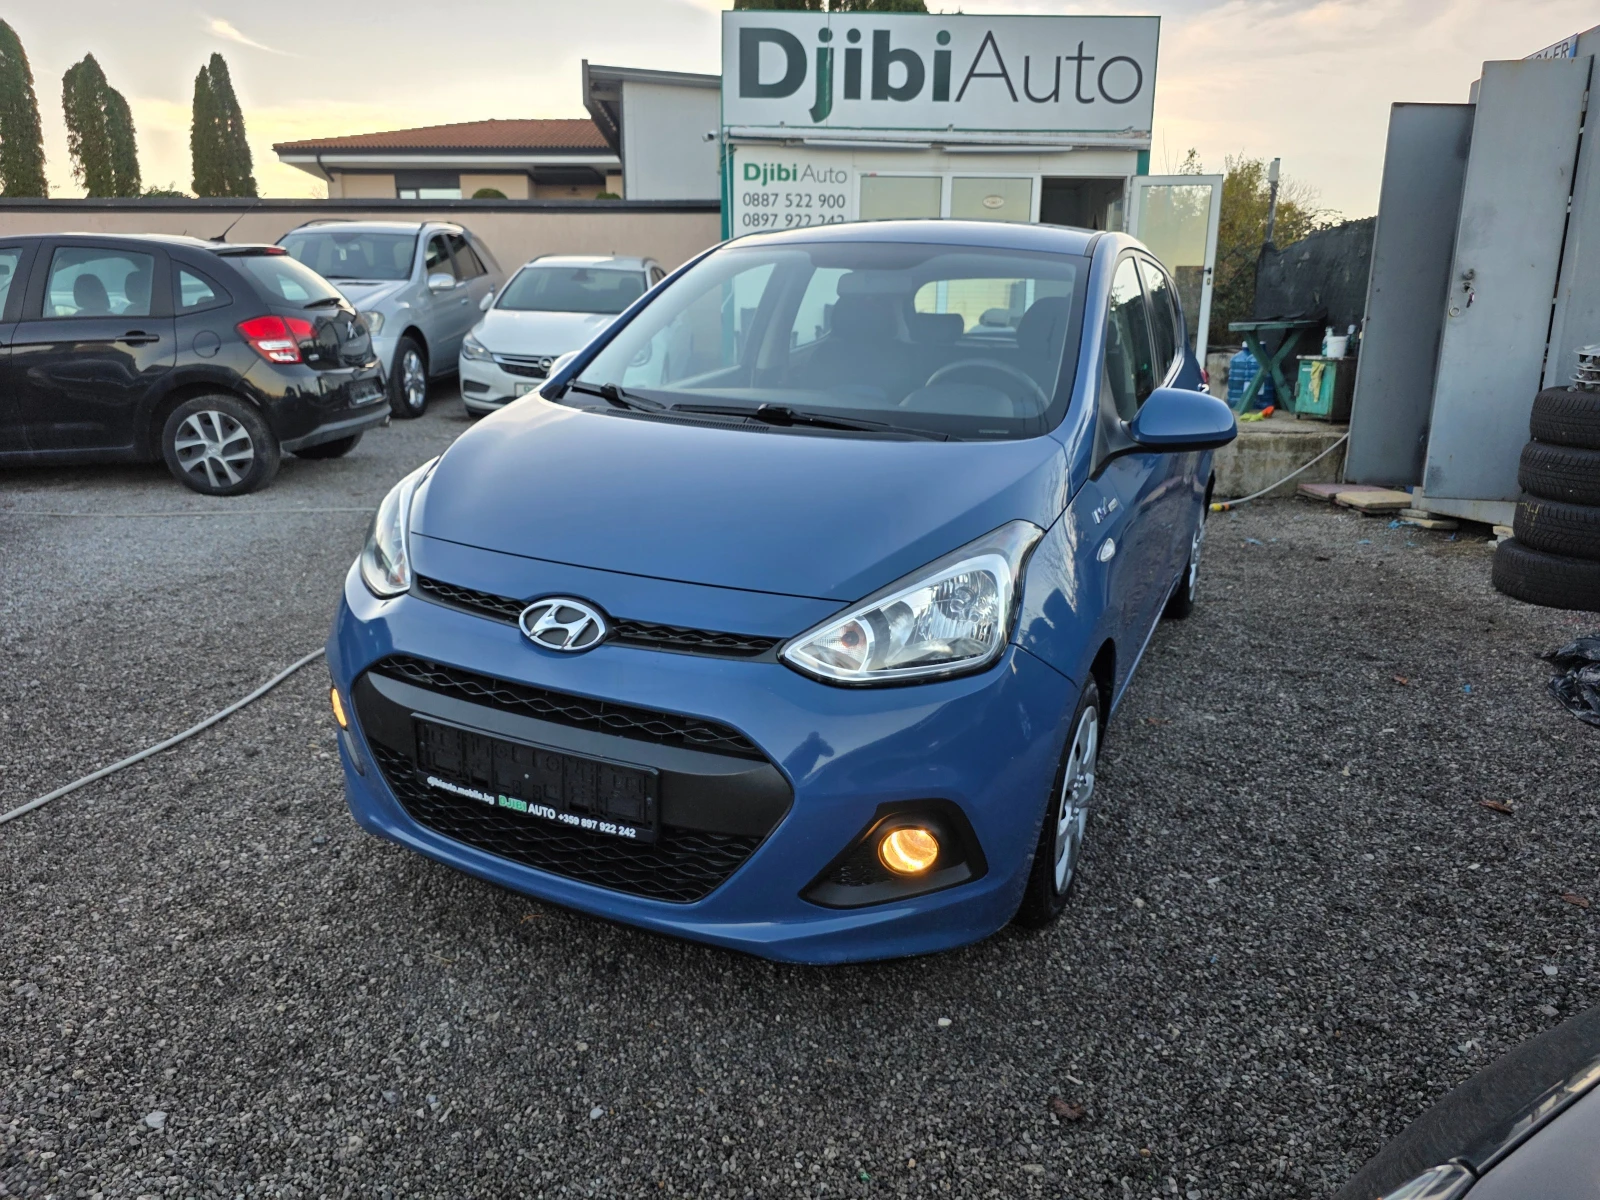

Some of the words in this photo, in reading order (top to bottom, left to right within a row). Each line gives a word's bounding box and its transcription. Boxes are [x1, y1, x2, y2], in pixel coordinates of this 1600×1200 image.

[743, 192, 779, 207] 0887
[785, 193, 812, 208] 522
[818, 194, 846, 209] 900
[742, 213, 778, 227] 0897
[785, 213, 812, 228] 922
[499, 795, 527, 812] DJIBI
[528, 803, 556, 819] AUTO
[558, 813, 580, 825] +359
[581, 818, 598, 830] 897
[599, 822, 617, 834] 922
[618, 826, 636, 838] 242
